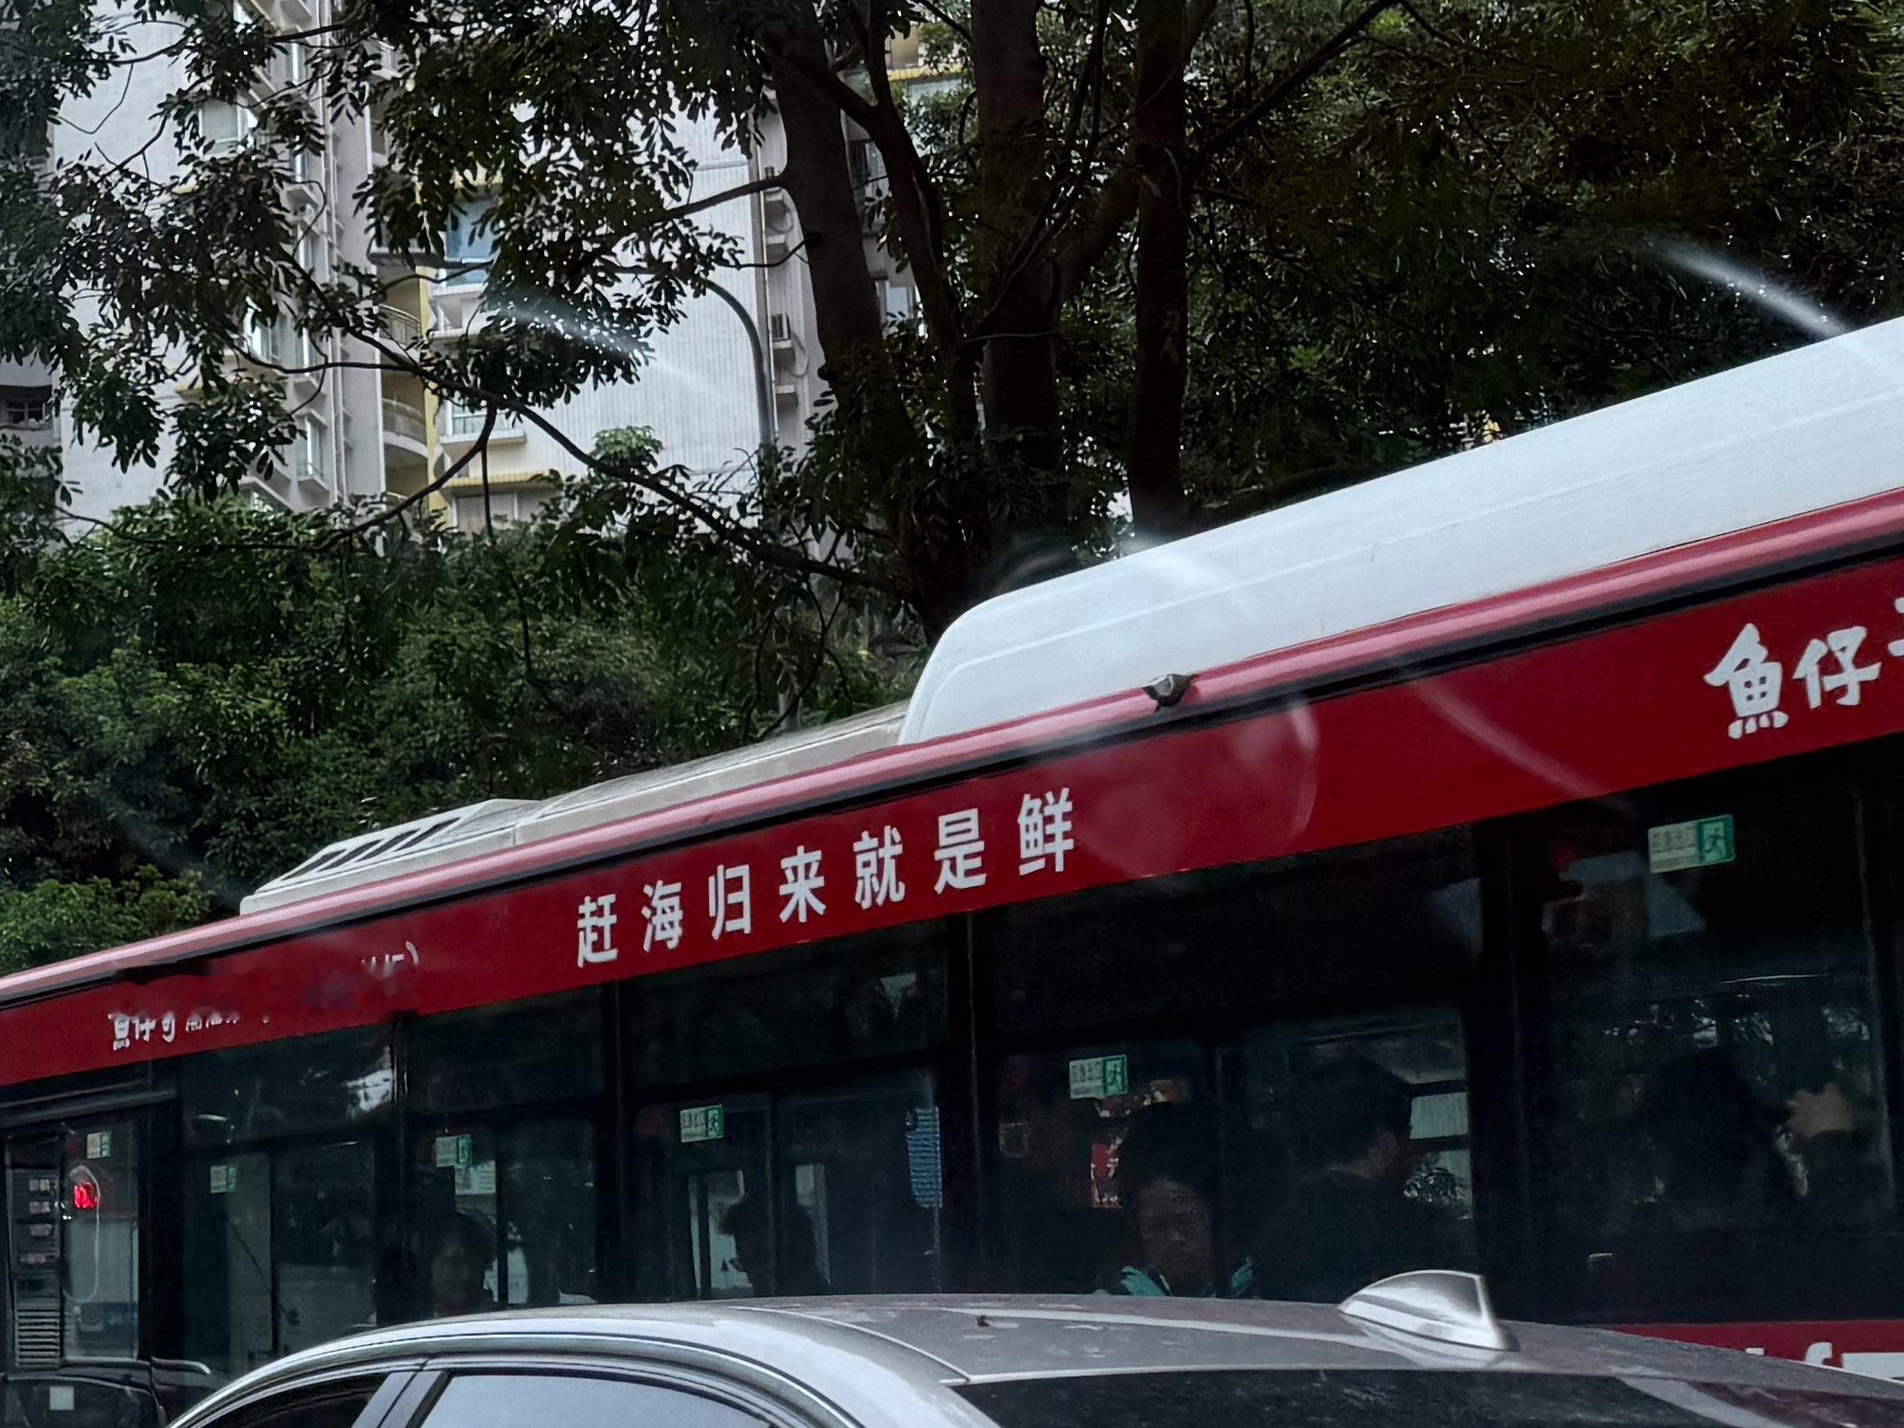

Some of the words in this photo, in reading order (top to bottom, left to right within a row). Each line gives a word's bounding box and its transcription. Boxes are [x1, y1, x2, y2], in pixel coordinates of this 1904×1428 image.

[1703, 597, 1904, 740] 魚仔
[577, 790, 1075, 968] 赶海归来就是鲜
